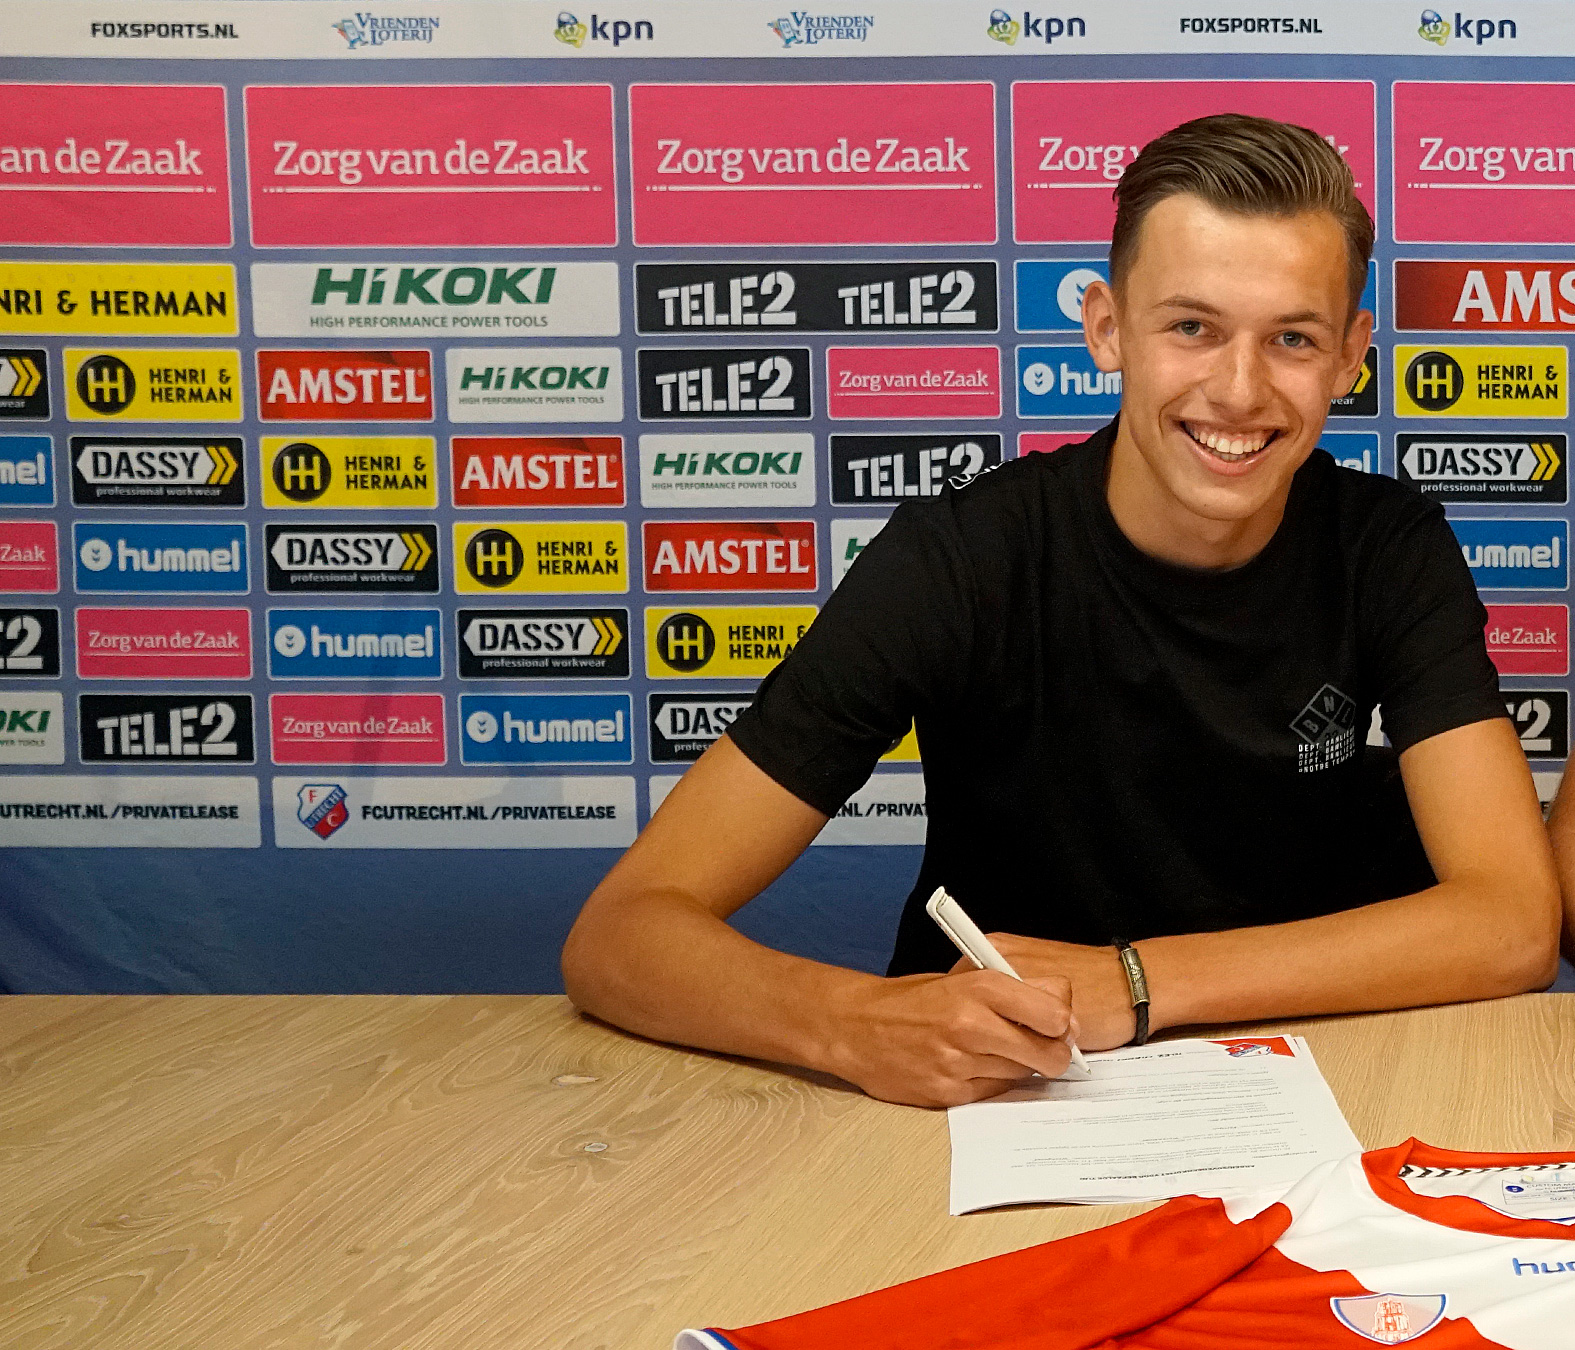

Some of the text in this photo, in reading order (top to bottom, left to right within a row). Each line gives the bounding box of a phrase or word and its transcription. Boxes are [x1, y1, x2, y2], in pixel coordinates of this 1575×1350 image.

[91, 23, 238, 38] FOXSPORTS.NL
[355, 12, 440, 29] VRIENDEN
[591, 15, 653, 46] kpn
[791, 11, 874, 28] VRIENDEN
[1024, 12, 1085, 44] kpn
[1180, 18, 1322, 33] FOXSPORTS.NL
[1455, 13, 1516, 45] kpn
[370, 27, 432, 46] LOTERIJ
[805, 27, 868, 45] LOTERIJ
[0, 138, 203, 175] an de Zaak
[274, 139, 589, 184] Zorg van de Zaak
[657, 138, 970, 183] Zorg van de Zaak
[1039, 138, 1126, 180] Zorg
[1420, 138, 1505, 181] Zorg
[57, 290, 78, 315] &
[91, 291, 226, 316] HERMAN
[658, 270, 976, 325] TELE2 TELE2
[310, 316, 548, 327] HIGH PERFORMANCE POWER TOOLS
[149, 368, 231, 384] HENRI &
[656, 356, 794, 411] TELE2
[840, 370, 988, 391] Zorg van de Zaak
[1478, 365, 1557, 380] HENRI &
[151, 388, 231, 403] HERMAN
[1478, 384, 1557, 399] HERMAN
[92, 446, 200, 479] DASSY
[345, 456, 426, 471] HENRI &
[1418, 448, 1523, 476] DASSY
[347, 475, 426, 489] HERMAN
[675, 481, 735, 490] PERFORMANCE
[1421, 482, 1543, 493] professional workwear
[118, 539, 240, 572] hummel
[287, 534, 400, 565] DASSY
[1462, 537, 1560, 568] ummel
[290, 573, 415, 584] professional workwear
[89, 631, 239, 652] Zorg van de Zaak
[311, 625, 433, 657] hummel
[476, 618, 585, 651] DASSY
[729, 626, 783, 641] HENRI
[1489, 628, 1557, 644] de Zaak
[97, 702, 237, 755] TELE2
[504, 710, 624, 743] hummel
